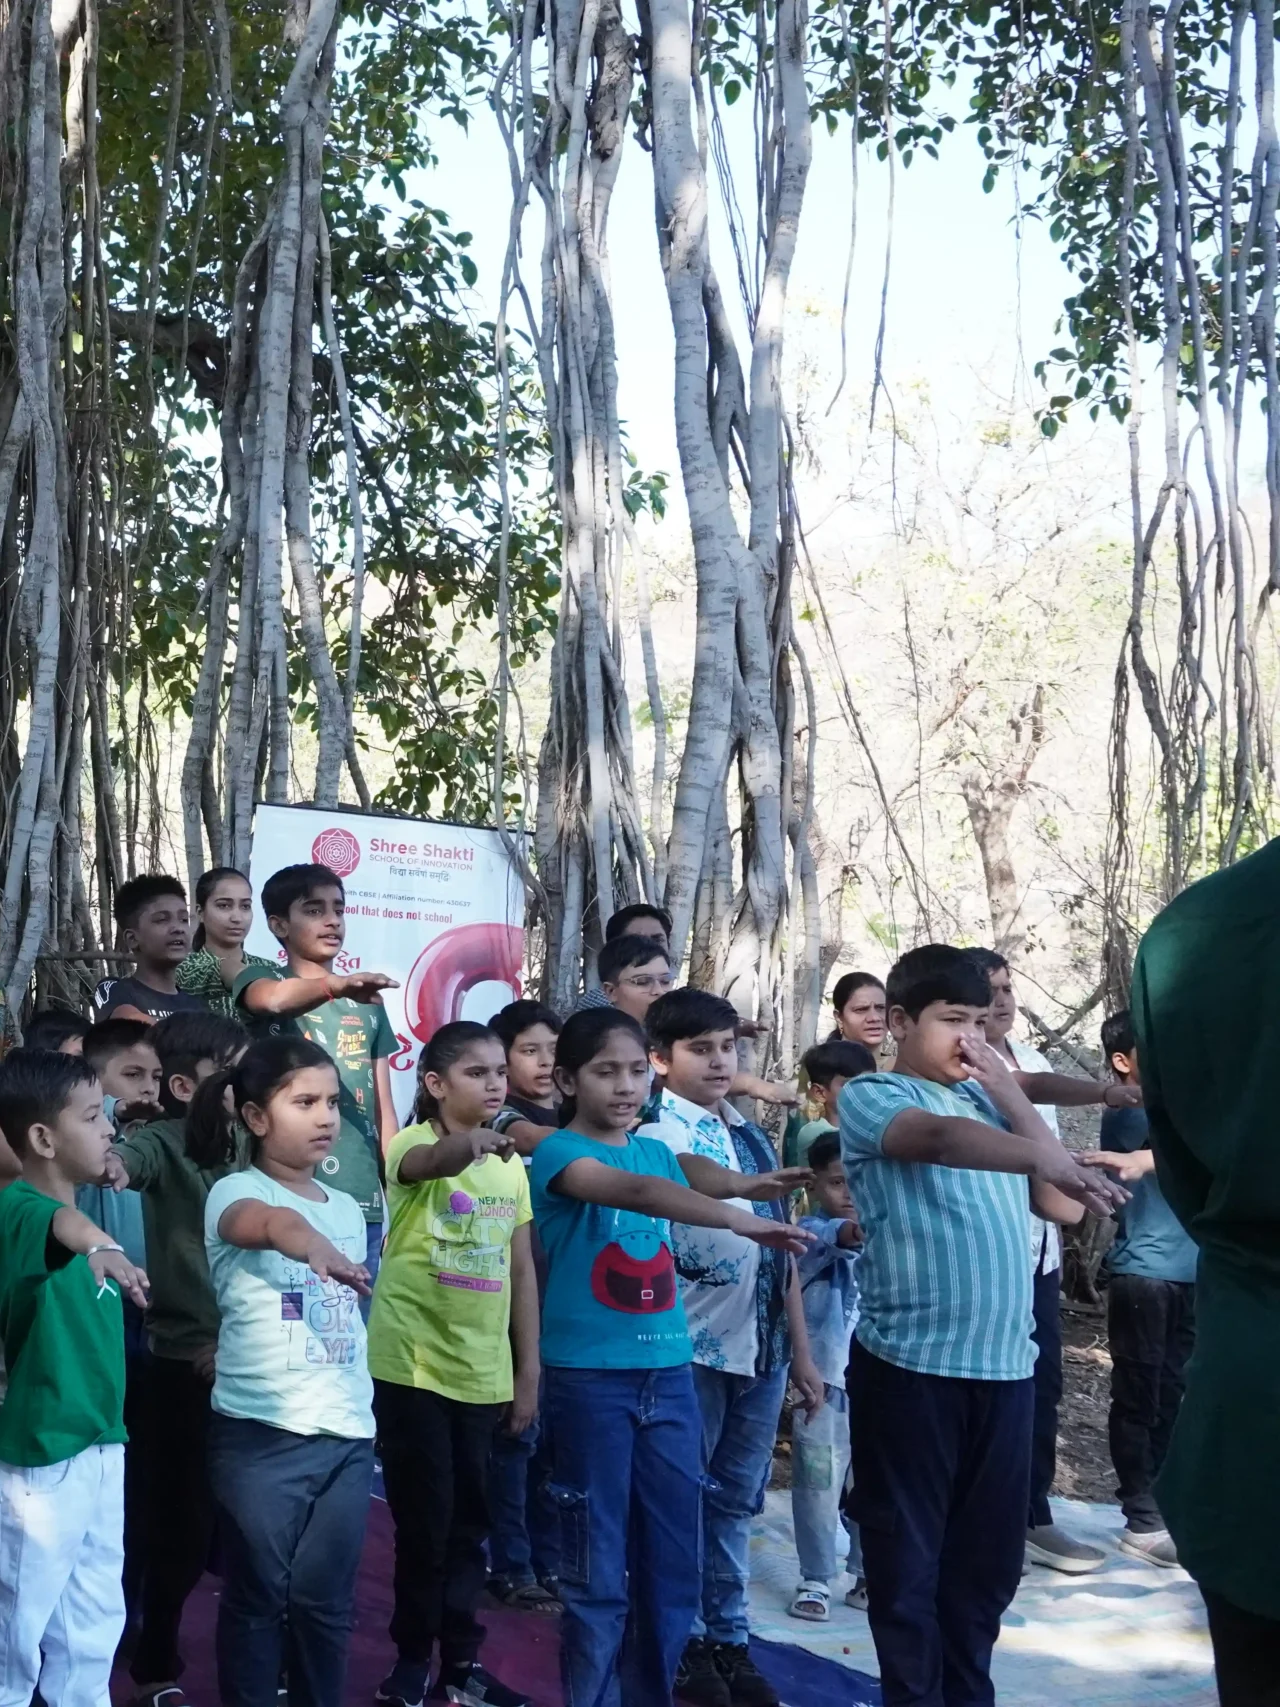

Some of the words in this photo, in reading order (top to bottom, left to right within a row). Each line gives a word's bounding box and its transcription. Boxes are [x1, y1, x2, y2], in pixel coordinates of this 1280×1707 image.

[370, 838, 418, 855] Shree
[423, 844, 475, 862] Shakti
[369, 854, 404, 864] SCHOOL
[406, 857, 419, 866] OF
[421, 859, 473, 871] INNOVATION
[358, 890, 377, 898] CBSE
[382, 893, 416, 901] Affiliation
[361, 905, 380, 917] that
[382, 907, 403, 919] does
[406, 910, 421, 921] not
[424, 911, 453, 924] school
[478, 1196, 497, 1206] NEW
